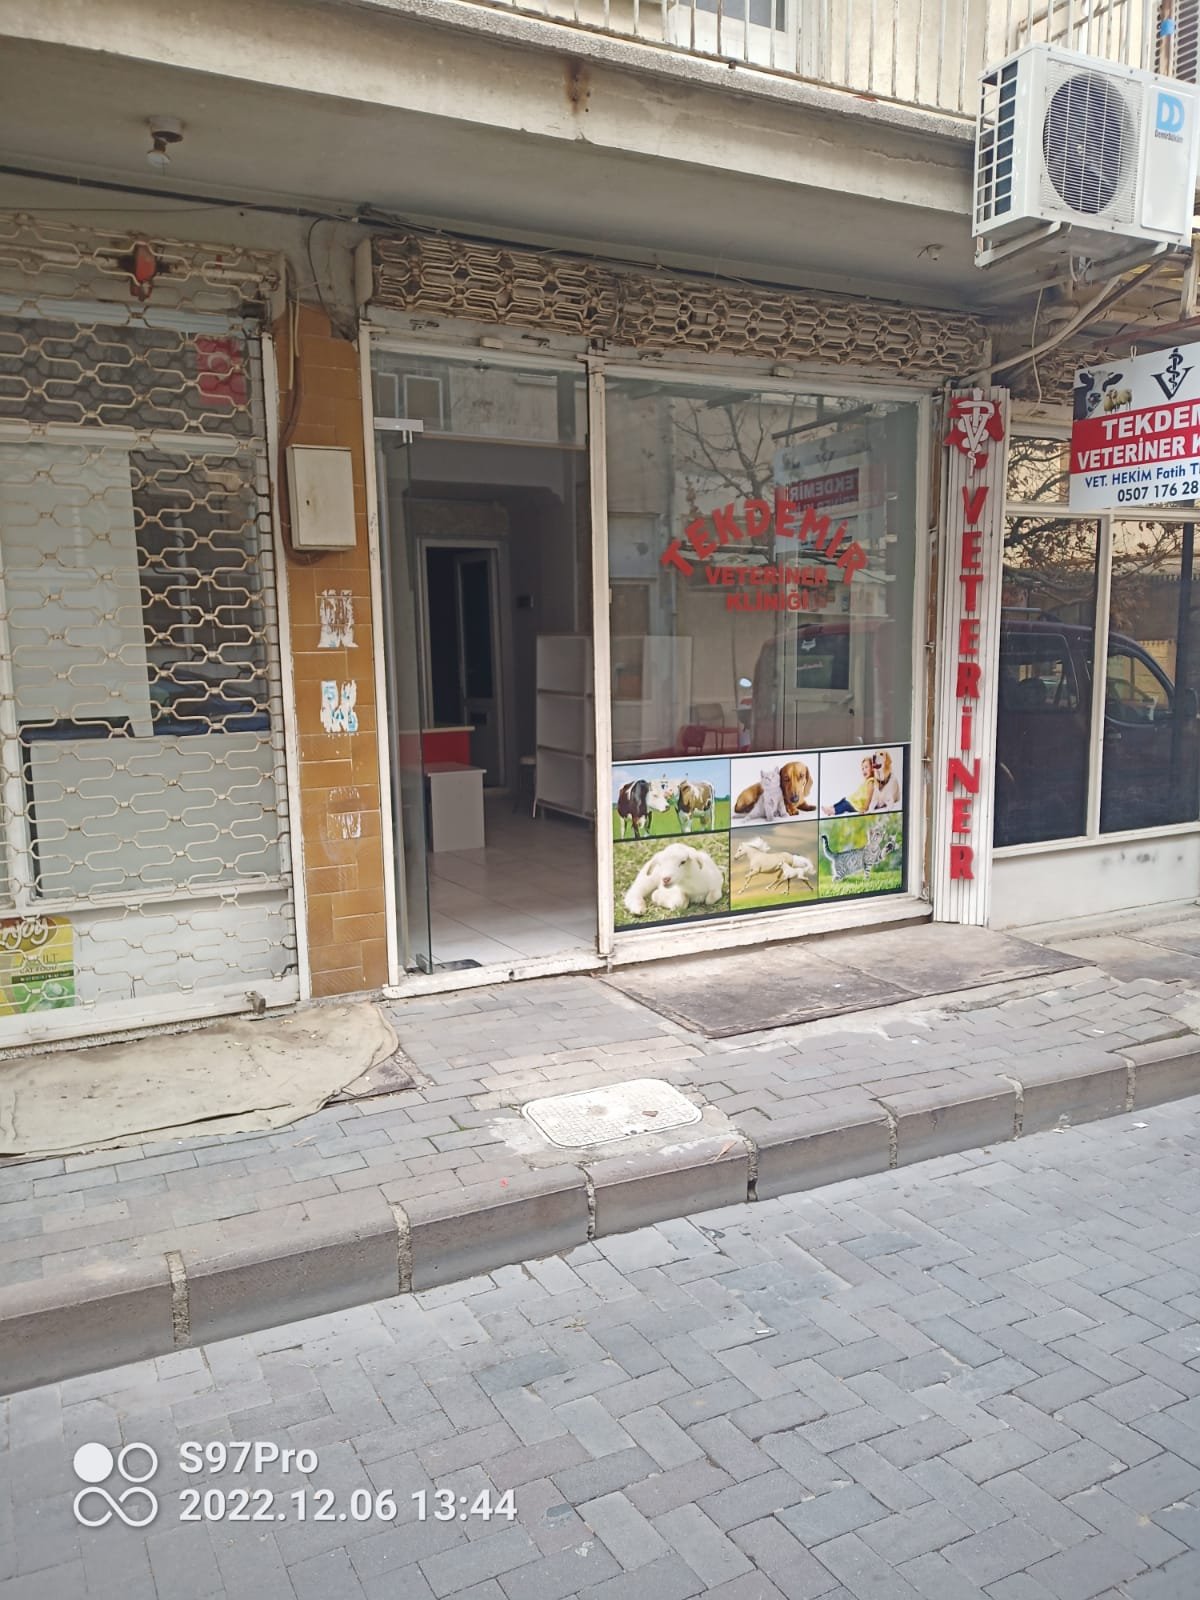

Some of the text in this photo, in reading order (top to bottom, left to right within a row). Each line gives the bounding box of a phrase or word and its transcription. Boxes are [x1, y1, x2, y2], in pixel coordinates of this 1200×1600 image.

[1077, 435, 1186, 470] VETERİNER
[1085, 474, 1107, 488] VET.
[1112, 467, 1152, 486] HEKİM
[1156, 464, 1186, 480] Fatih
[1118, 480, 1199, 502] 0507 176 28
[660, 498, 869, 586] TEKDEMİR
[705, 562, 829, 586] VETERİNER
